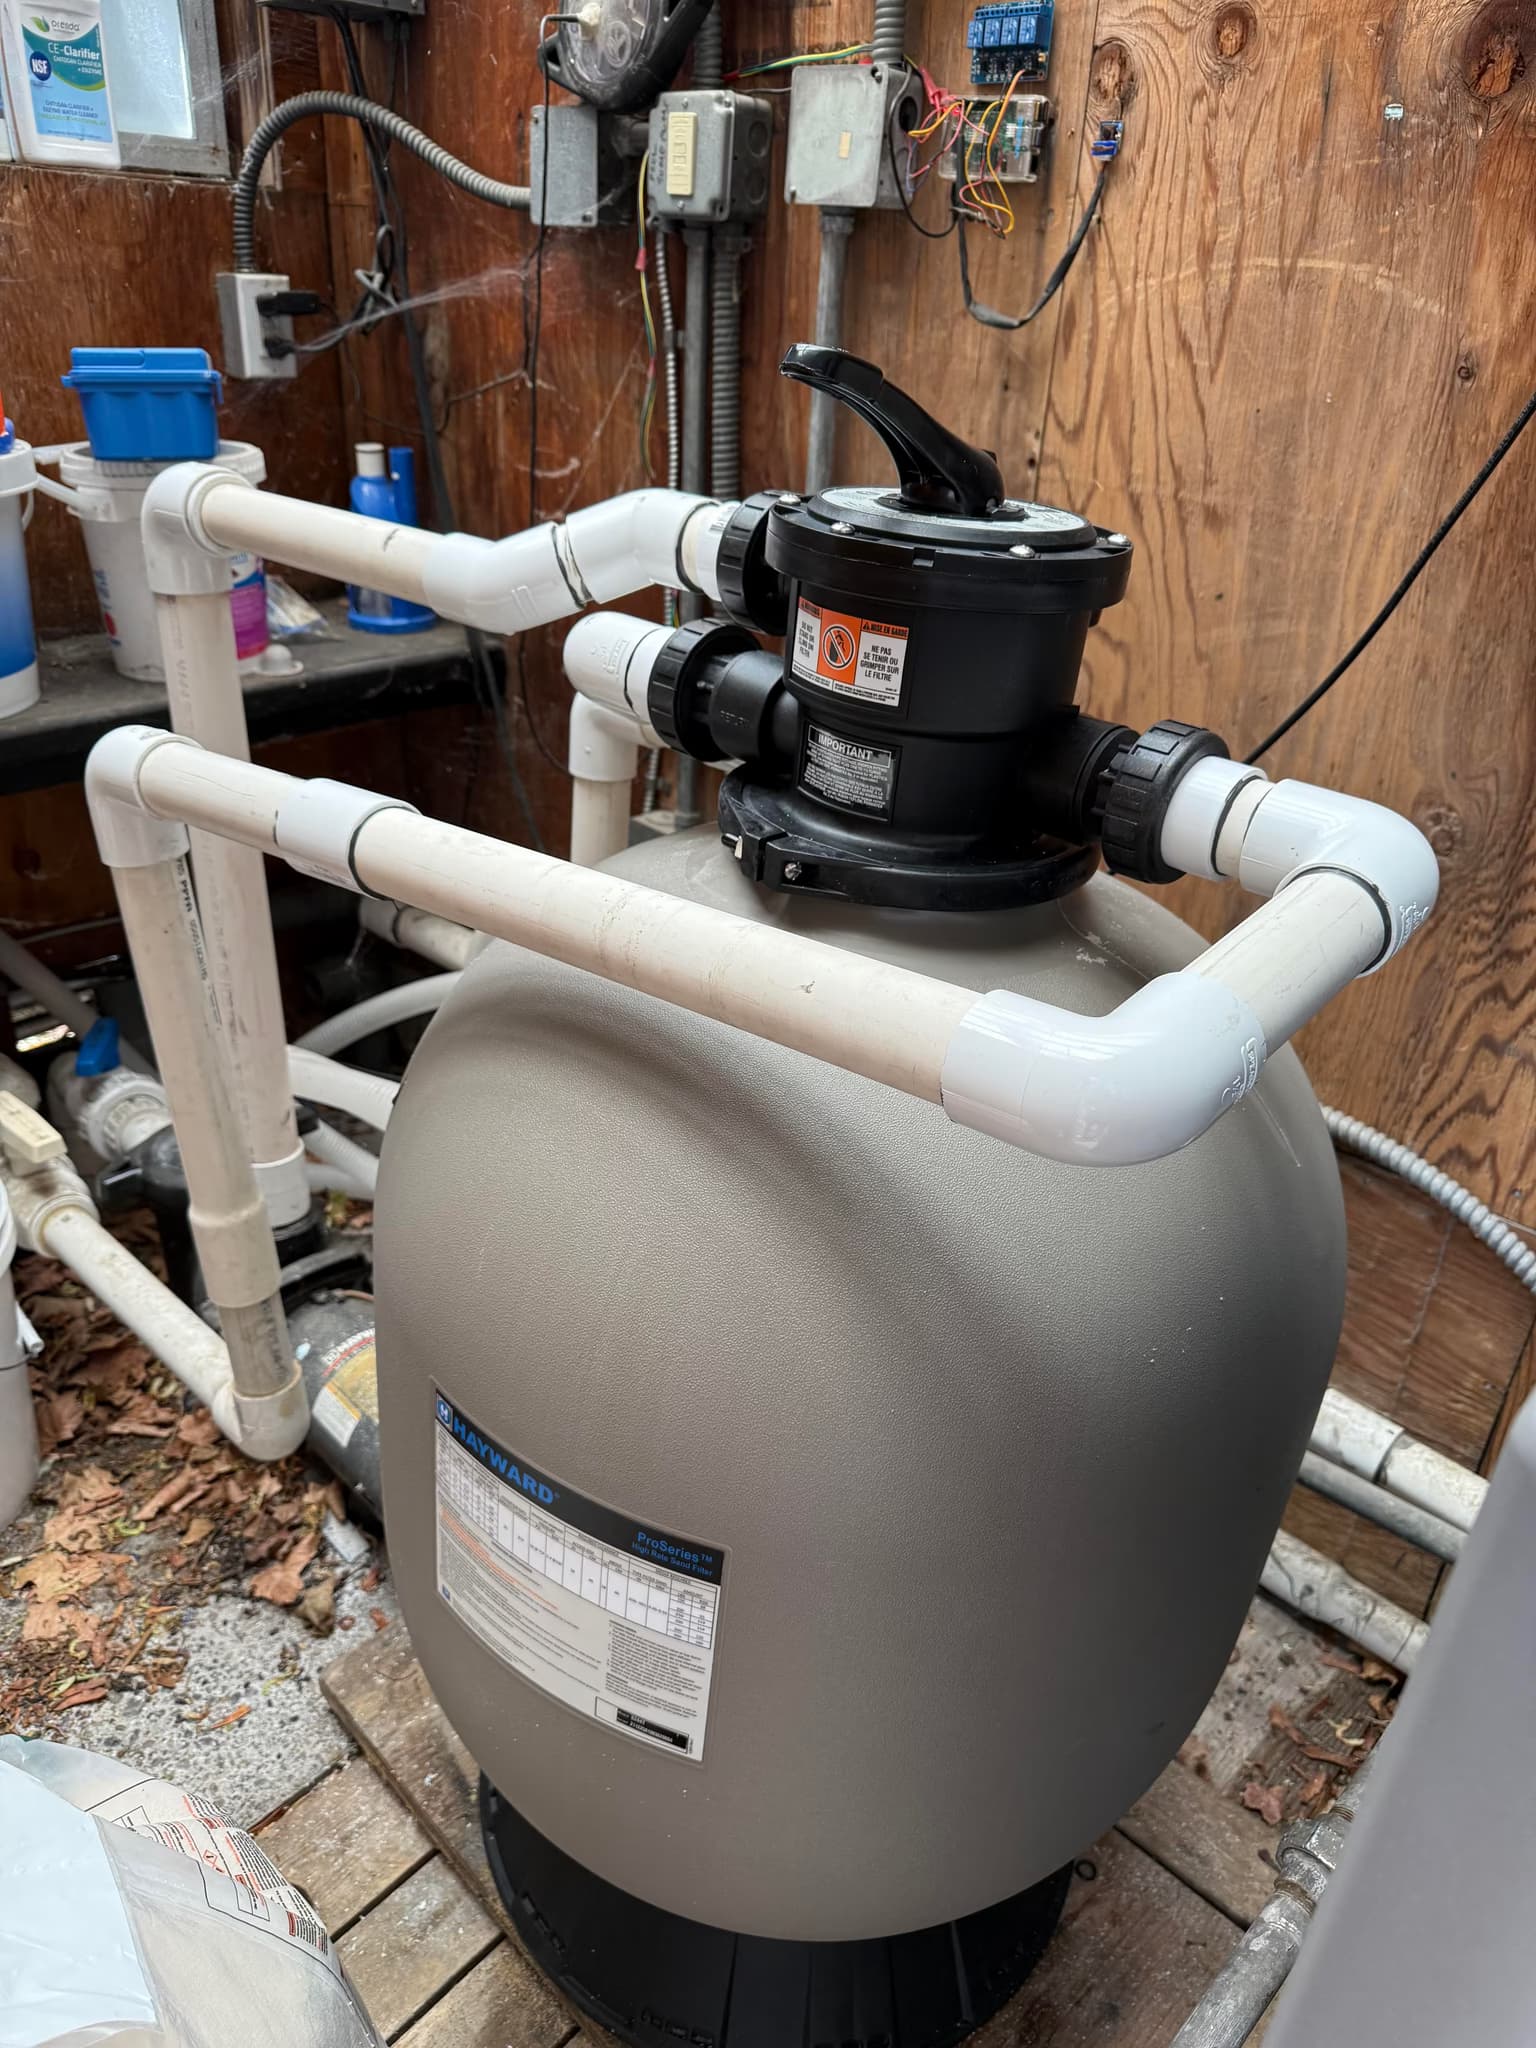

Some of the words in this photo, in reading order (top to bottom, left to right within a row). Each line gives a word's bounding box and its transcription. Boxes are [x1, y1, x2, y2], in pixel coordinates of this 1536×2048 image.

[48, 42, 100, 60] CE-Clarifier
[31, 58, 49, 75] NSF
[631, 541, 650, 556] High
[650, 549, 669, 563] Rate
[670, 556, 691, 570] Sand
[692, 563, 713, 577] Filter
[871, 645, 879, 653] NE
[880, 647, 892, 656] PAS
[860, 660, 885, 672] GRIMPER
[886, 665, 899, 675] SUR
[871, 653, 889, 664] TENIR
[889, 657, 898, 666] OU
[864, 669, 872, 678] LE
[872, 671, 891, 682] FILTRE
[818, 733, 872, 761] IMPORTANT
[453, 1416, 554, 1504] HAYWARD
